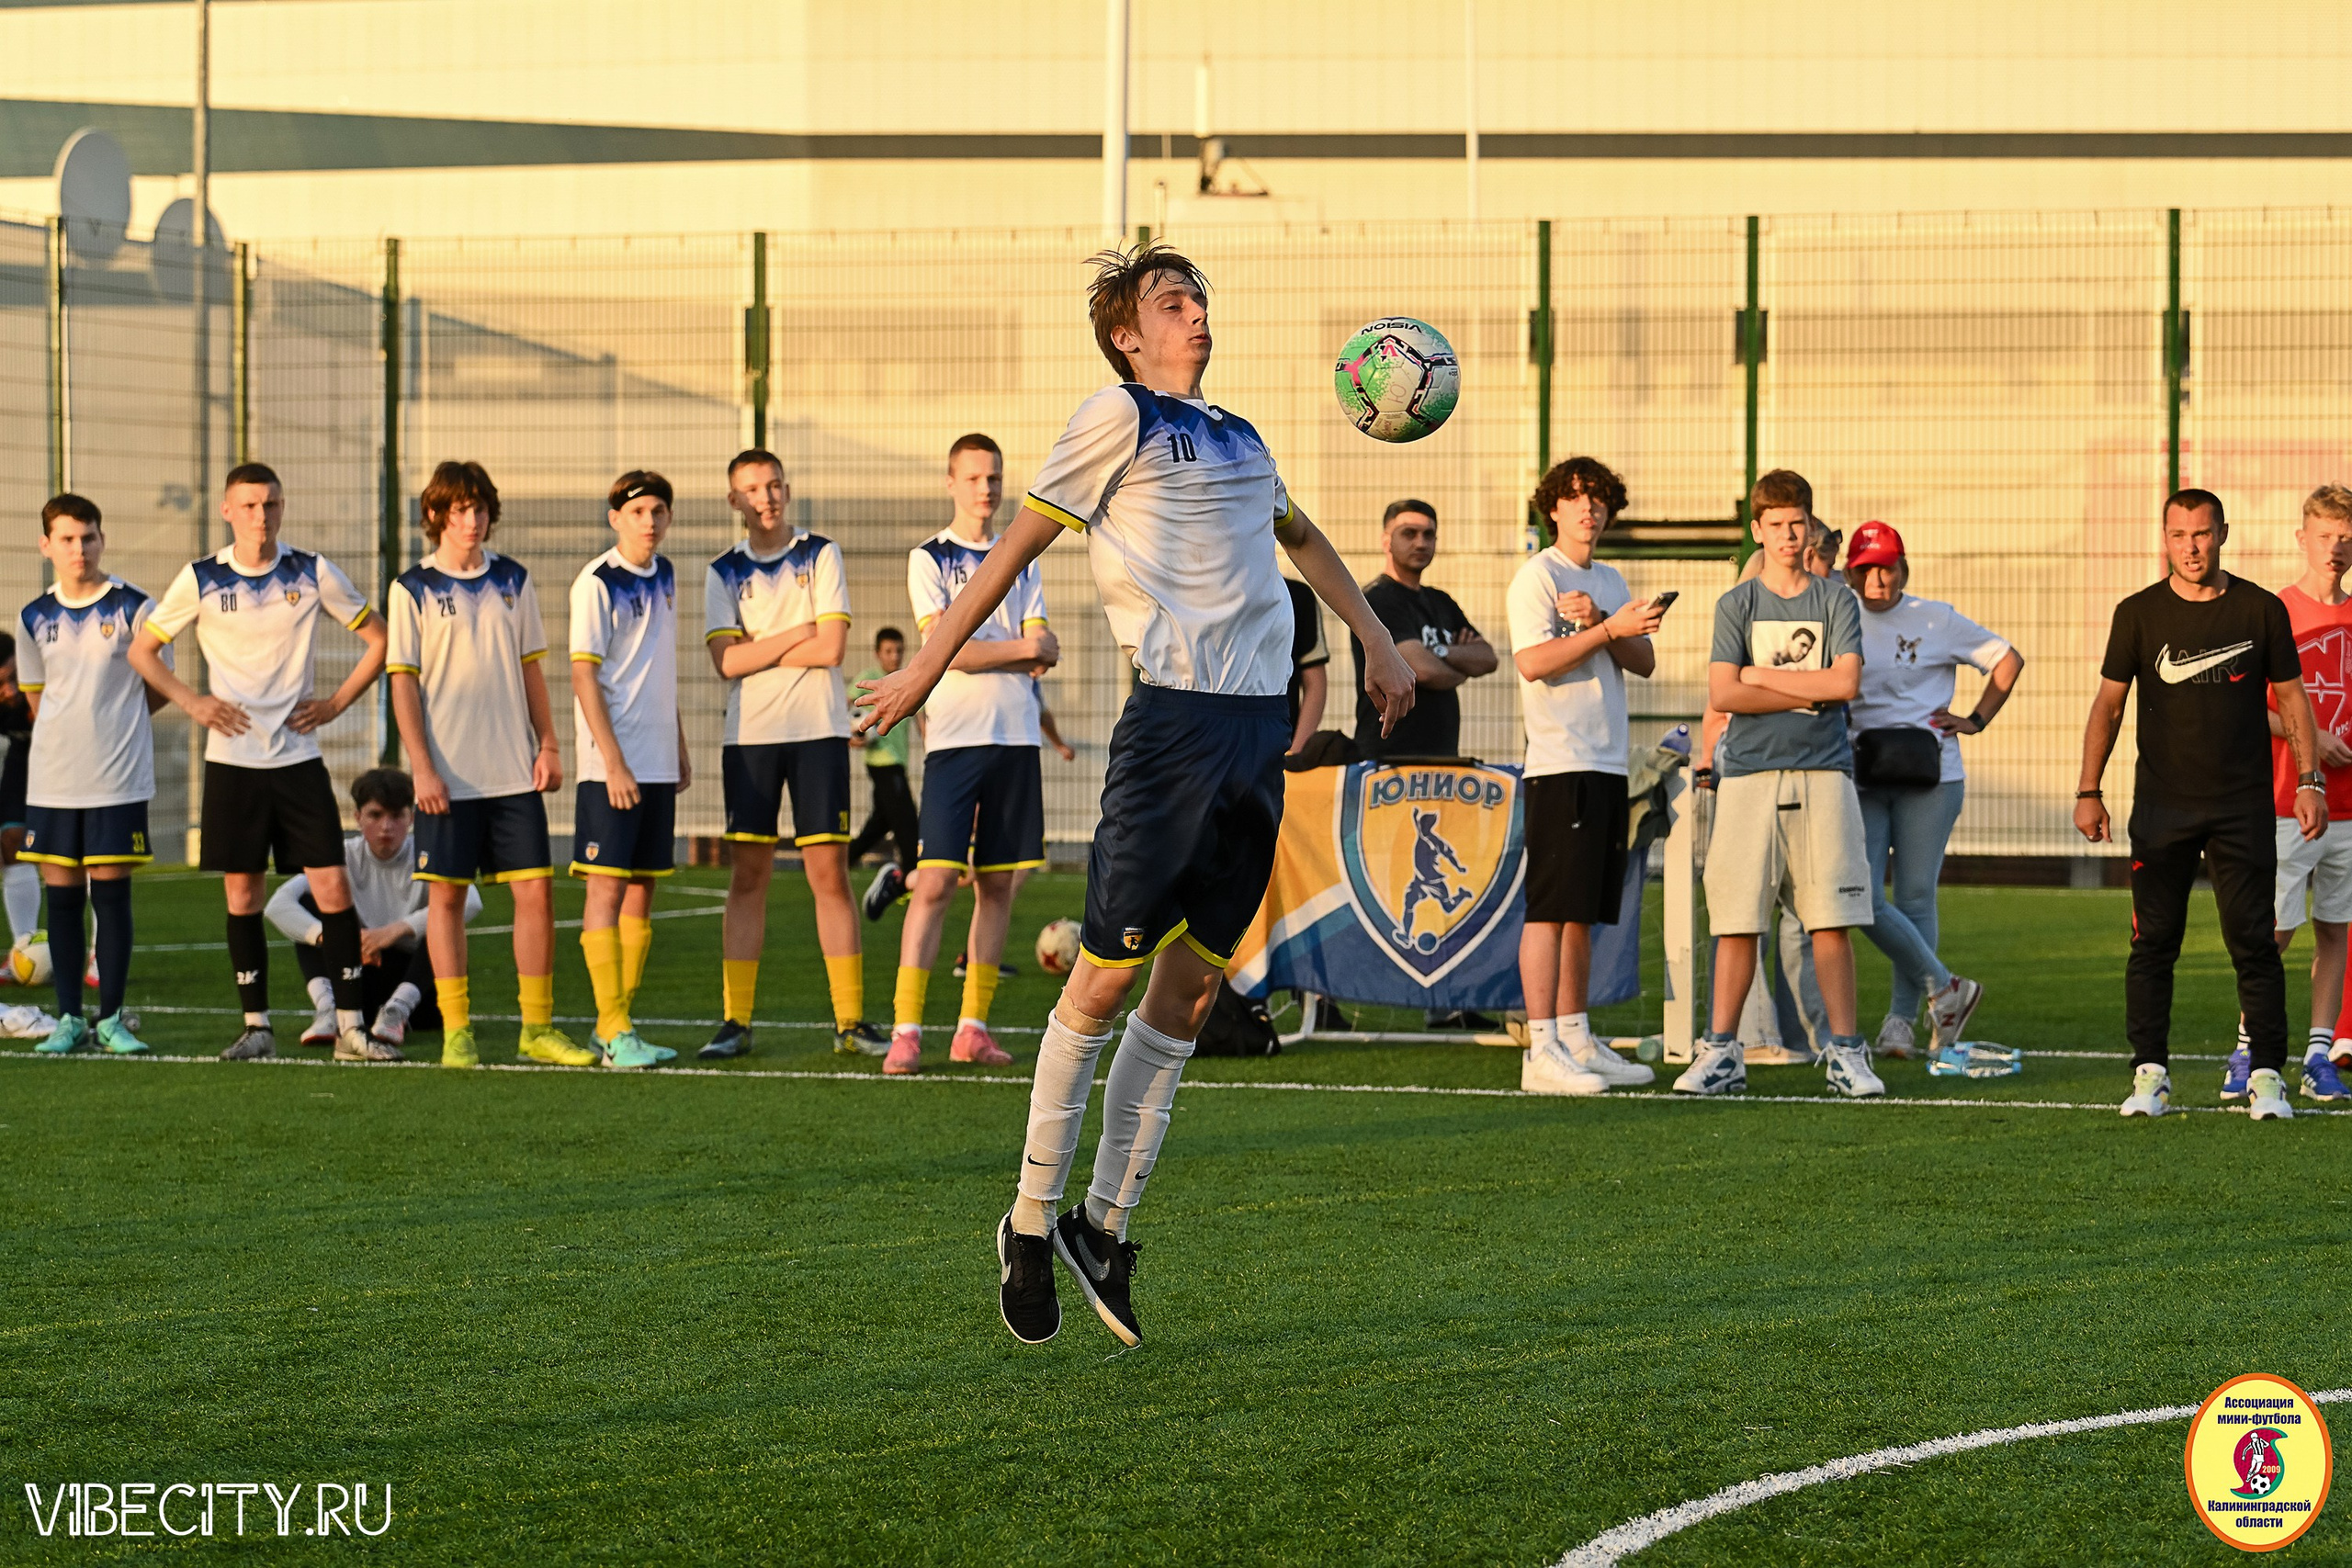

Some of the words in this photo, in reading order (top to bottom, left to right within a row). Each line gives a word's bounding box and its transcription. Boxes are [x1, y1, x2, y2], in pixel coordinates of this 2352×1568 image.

[1361, 321, 1422, 335] VISION
[1167, 433, 1197, 463] 10
[220, 592, 238, 613] 80
[1370, 771, 1505, 809] ЮНИОР
